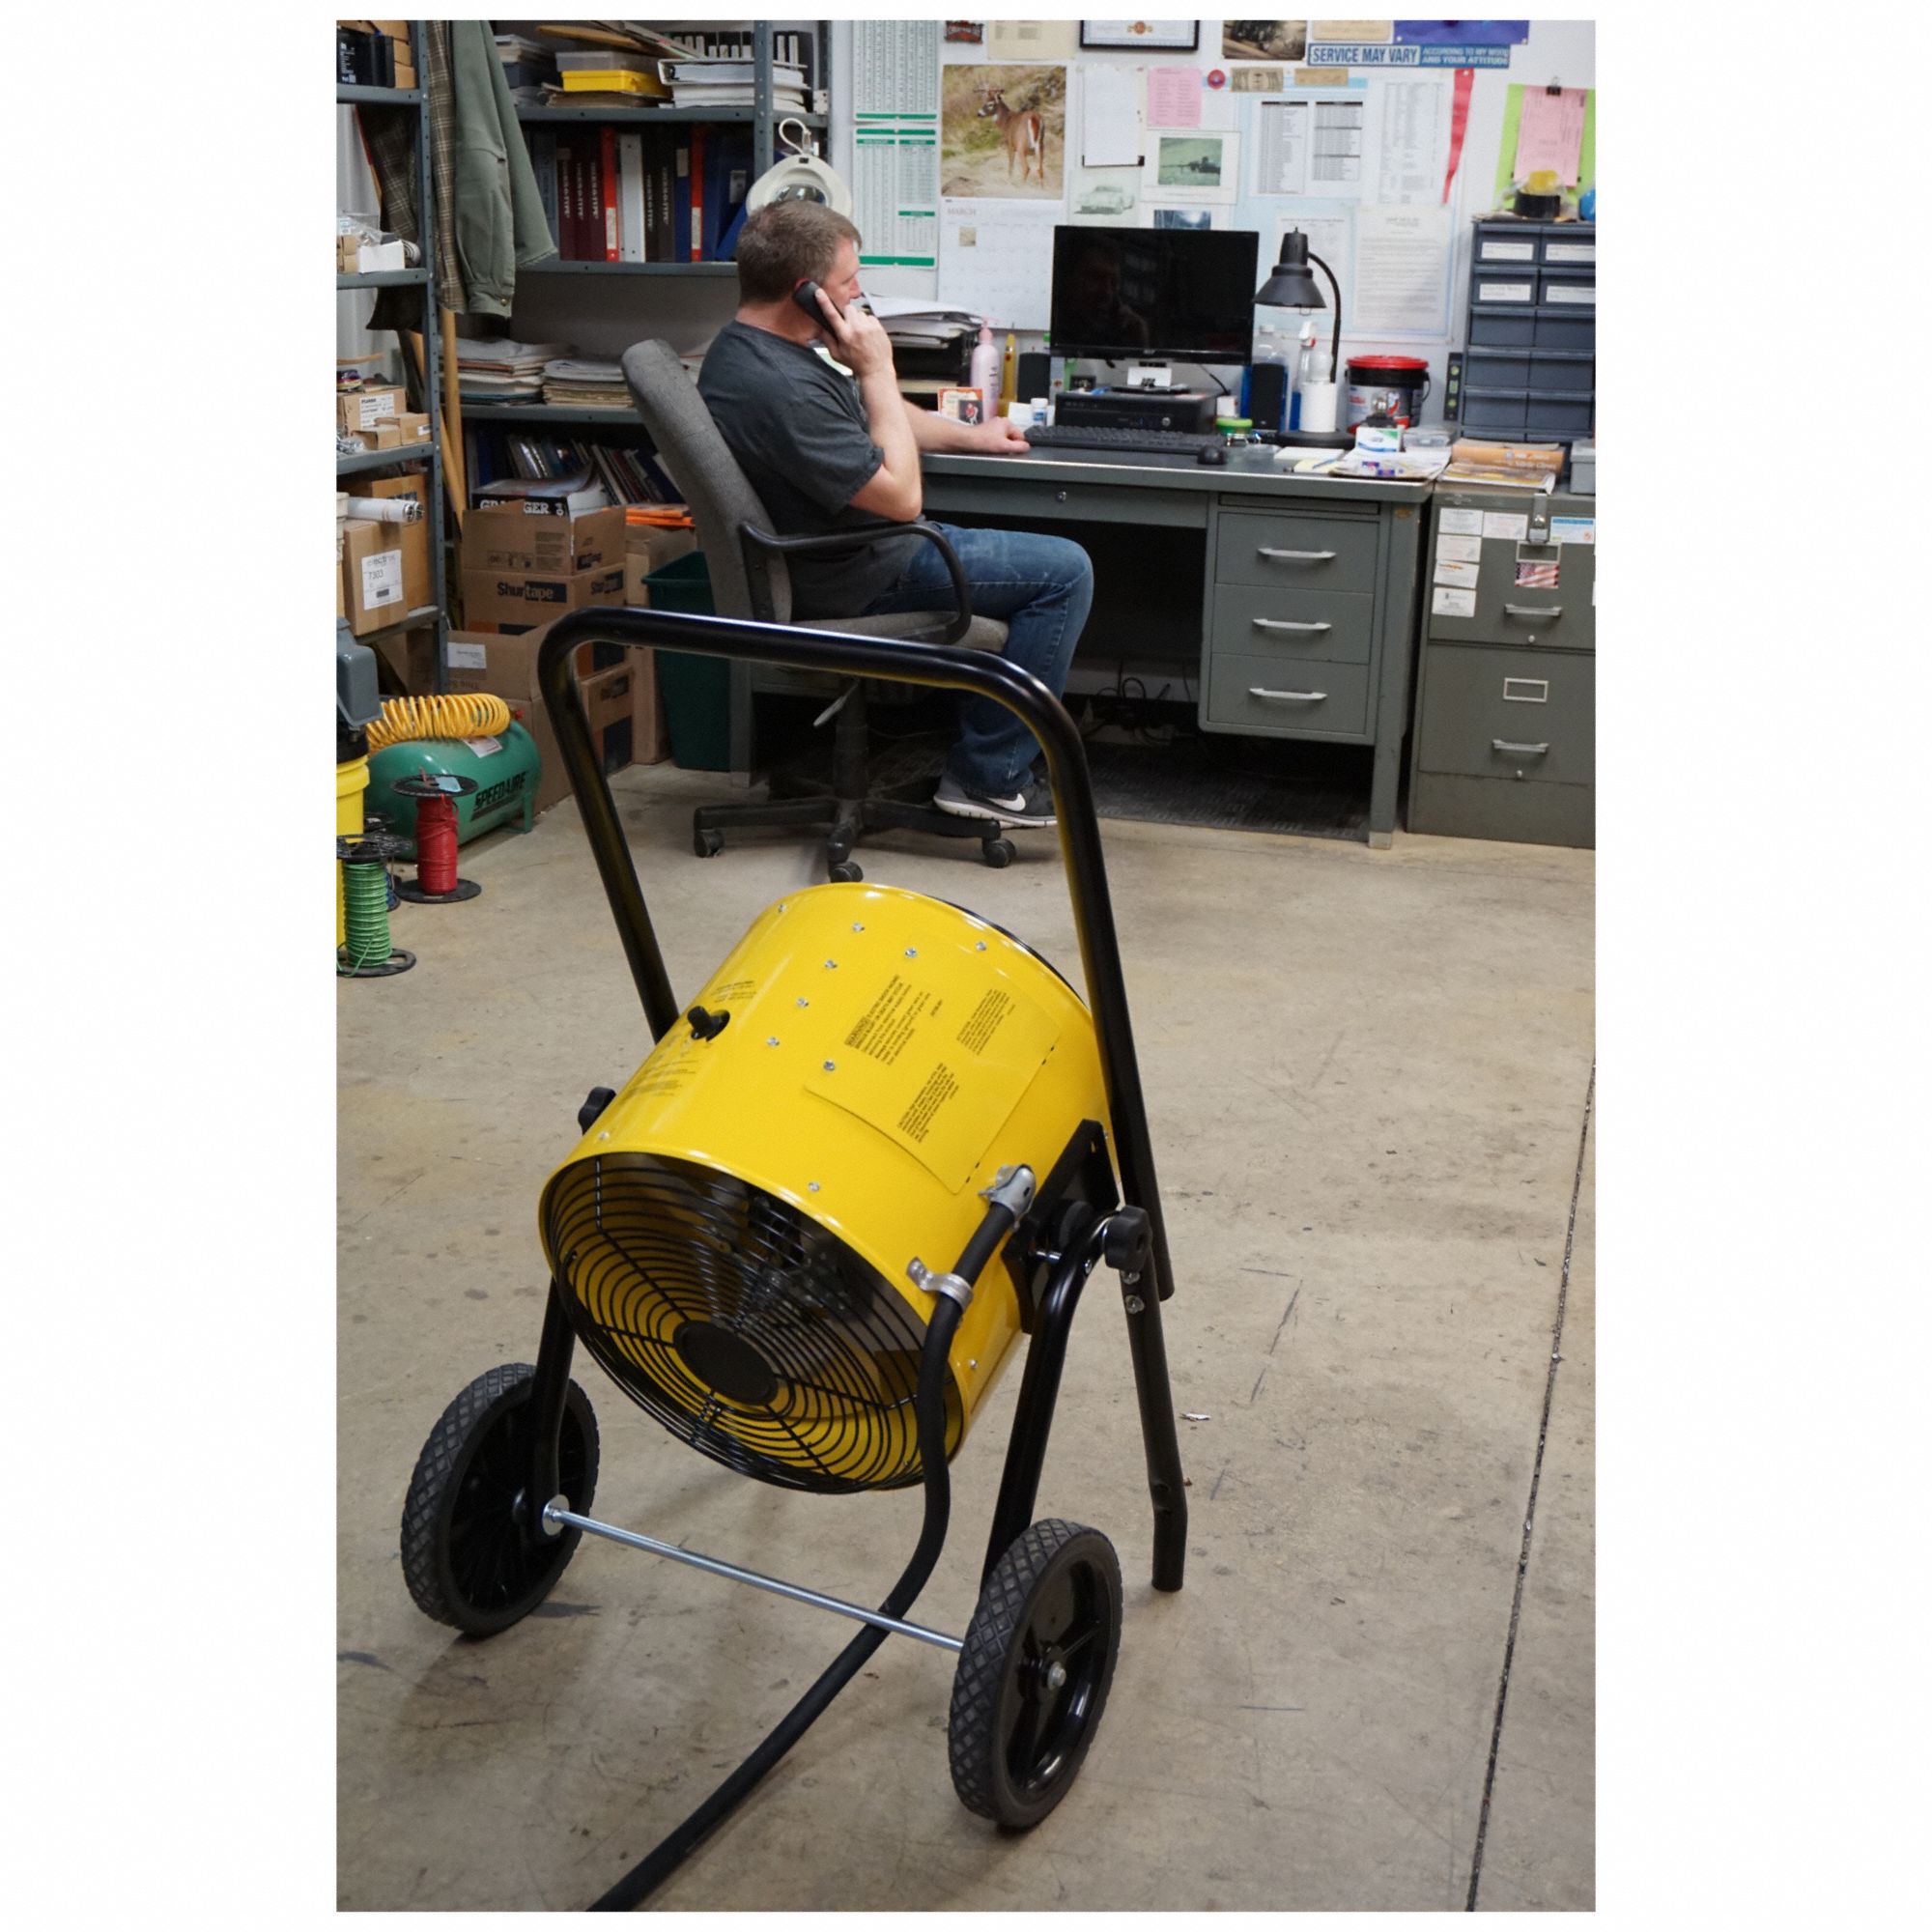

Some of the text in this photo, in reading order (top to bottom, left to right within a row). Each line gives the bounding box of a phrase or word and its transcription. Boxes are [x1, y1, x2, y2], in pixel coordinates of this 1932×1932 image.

[1312, 46, 1418, 64] SERVICE MAY VARY
[497, 581, 554, 603] Shurtape
[473, 771, 526, 811] SPEEDAIRE
